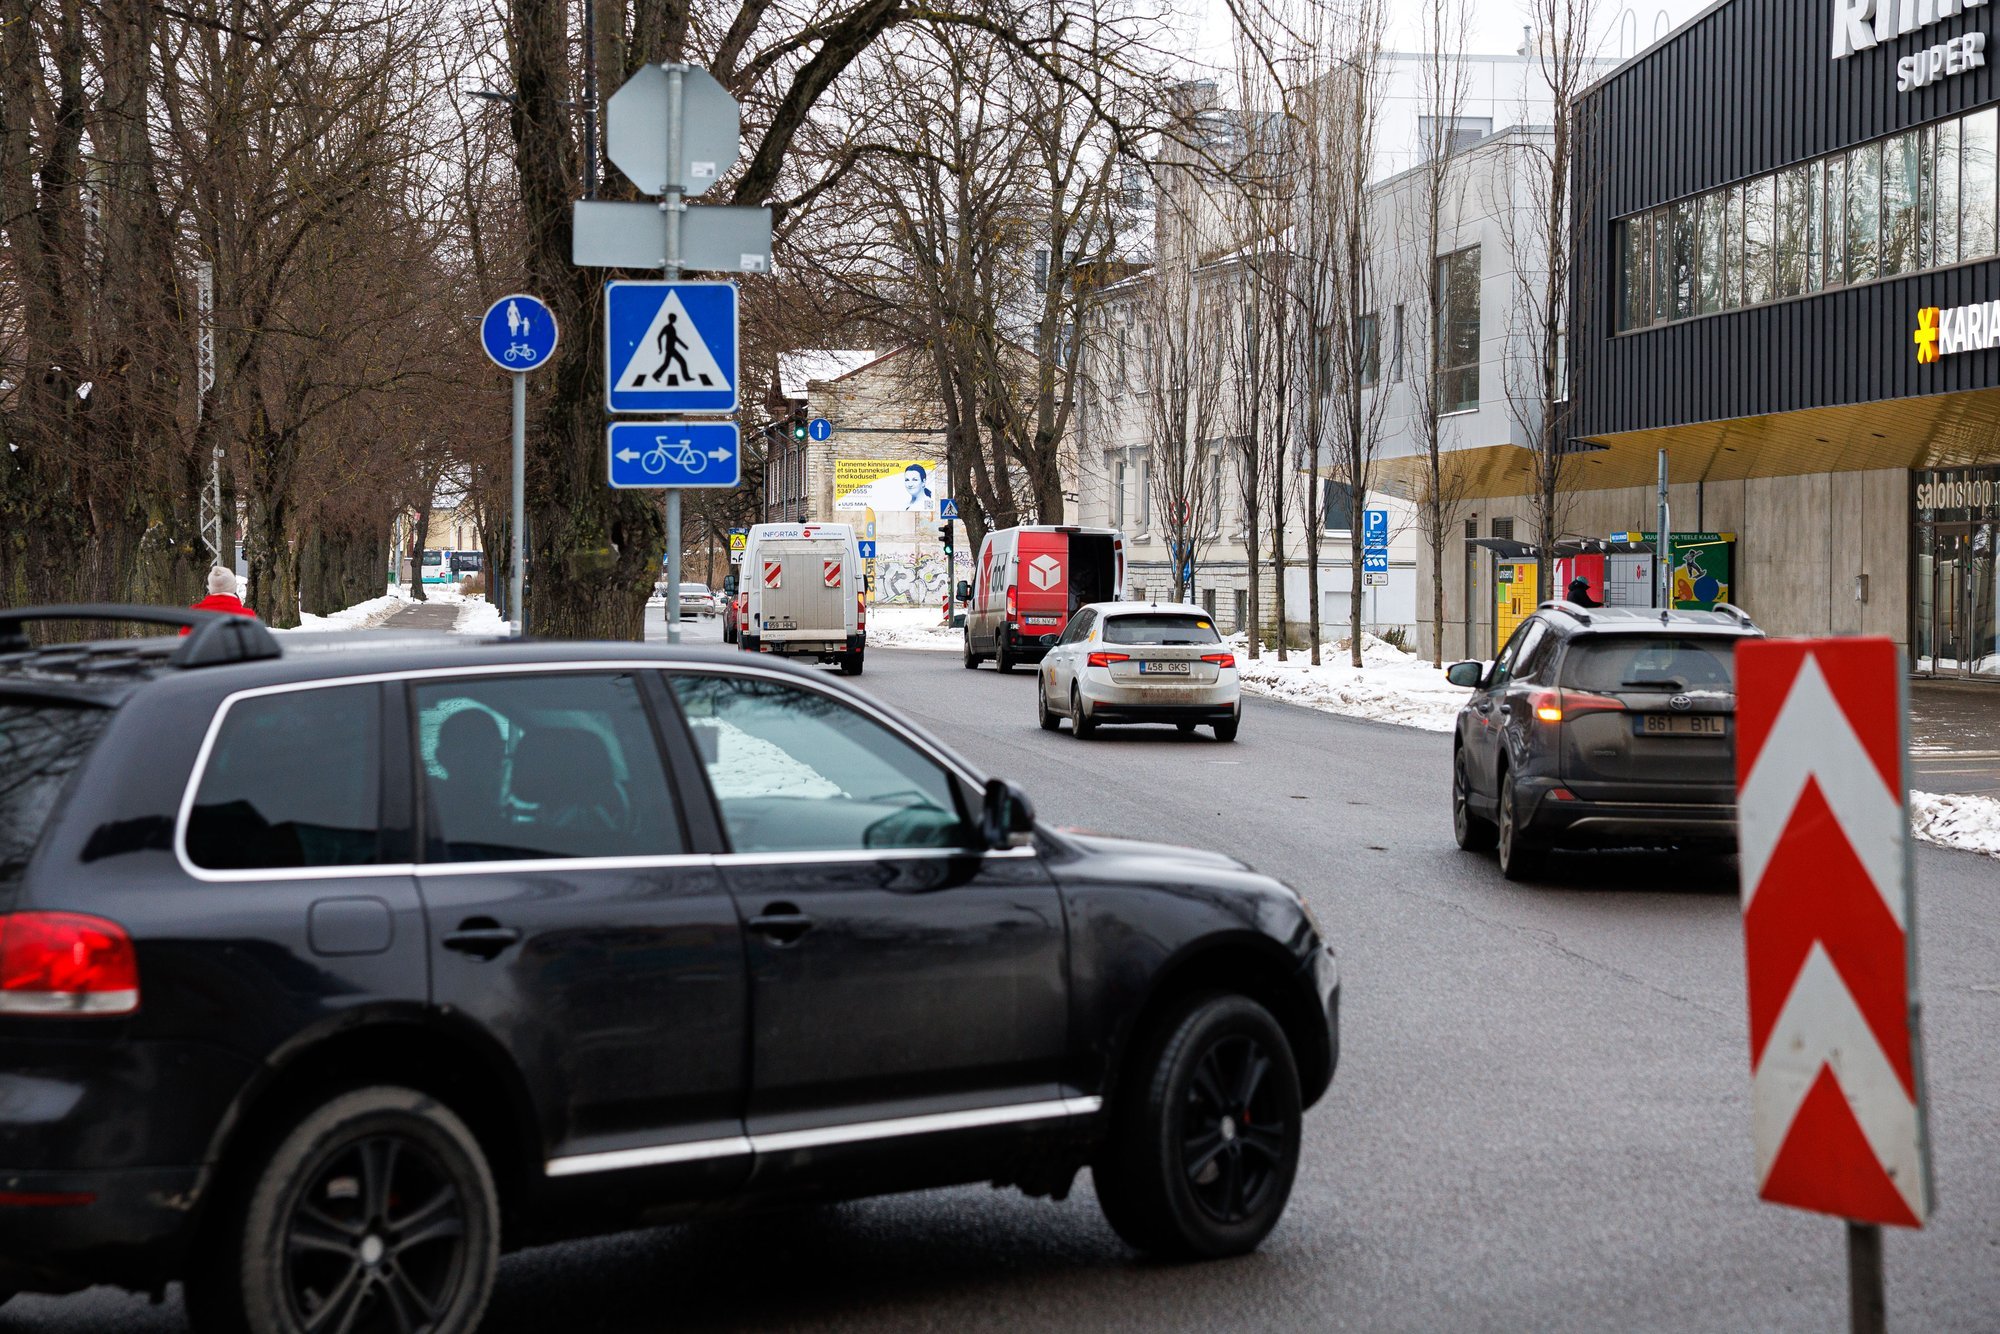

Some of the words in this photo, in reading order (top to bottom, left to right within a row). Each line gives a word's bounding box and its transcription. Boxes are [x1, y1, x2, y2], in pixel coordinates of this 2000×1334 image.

[1897, 31, 1986, 92] SUPER
[1370, 512, 1383, 530] P
[1147, 662, 1163, 671] 458
[1168, 663, 1188, 672] GKS
[1648, 716, 1673, 732] 861
[1691, 716, 1721, 732] BTL
